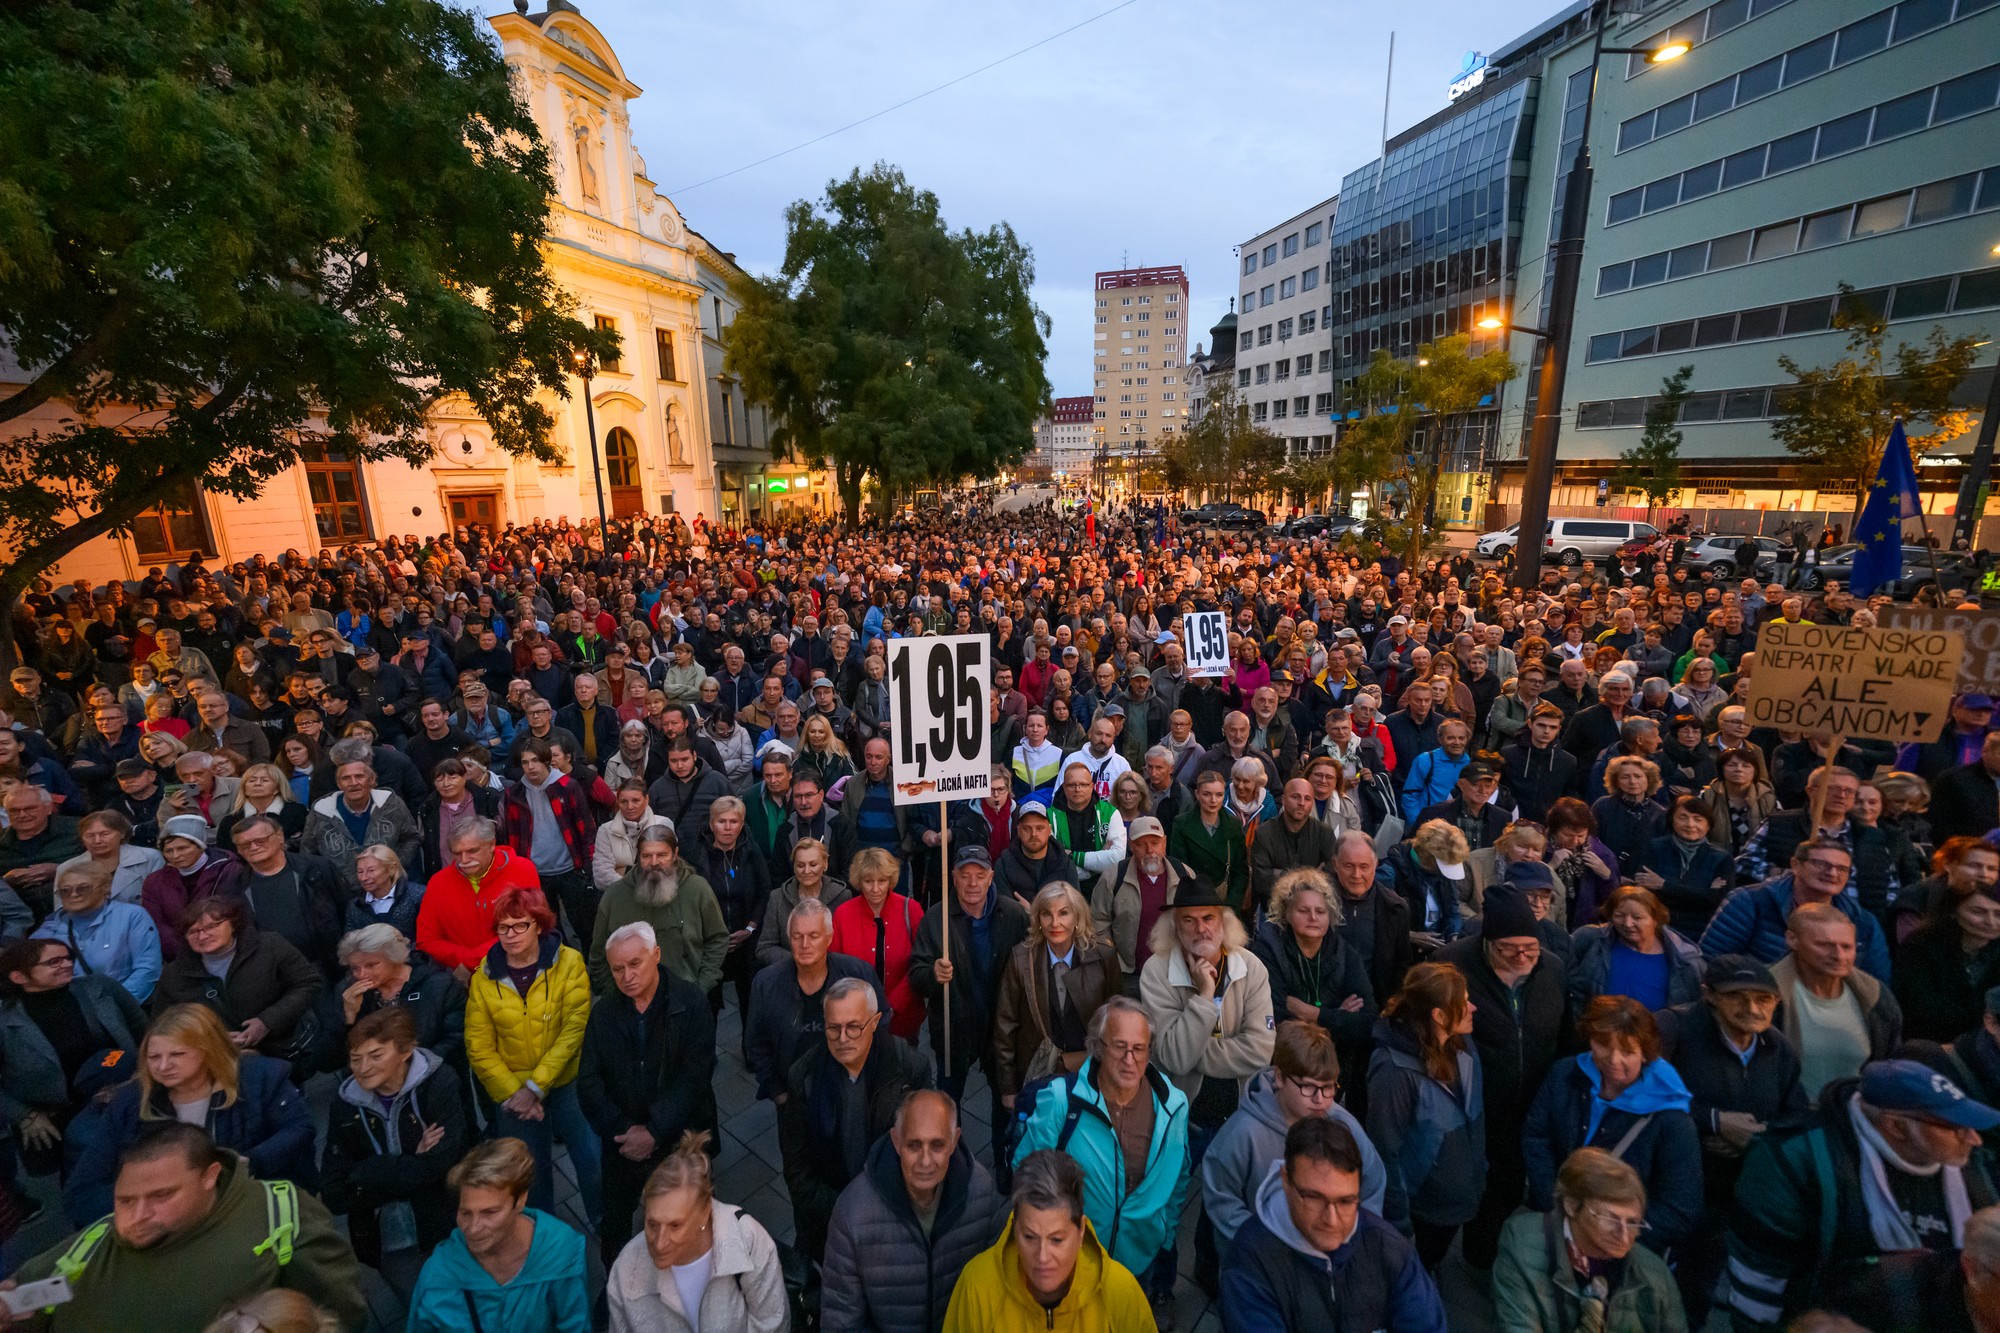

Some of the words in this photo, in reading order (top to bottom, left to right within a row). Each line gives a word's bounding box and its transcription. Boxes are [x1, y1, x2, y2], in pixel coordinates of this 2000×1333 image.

[1185, 614, 1225, 667] 1,95
[1764, 625, 1947, 656] SLOVENSKO
[1760, 650, 1856, 674] NEPATRÍ
[1802, 675, 1893, 706] ALE
[891, 641, 984, 779] 1,95
[937, 773, 963, 793] LACNÁ
[963, 773, 988, 791] NAFTA
